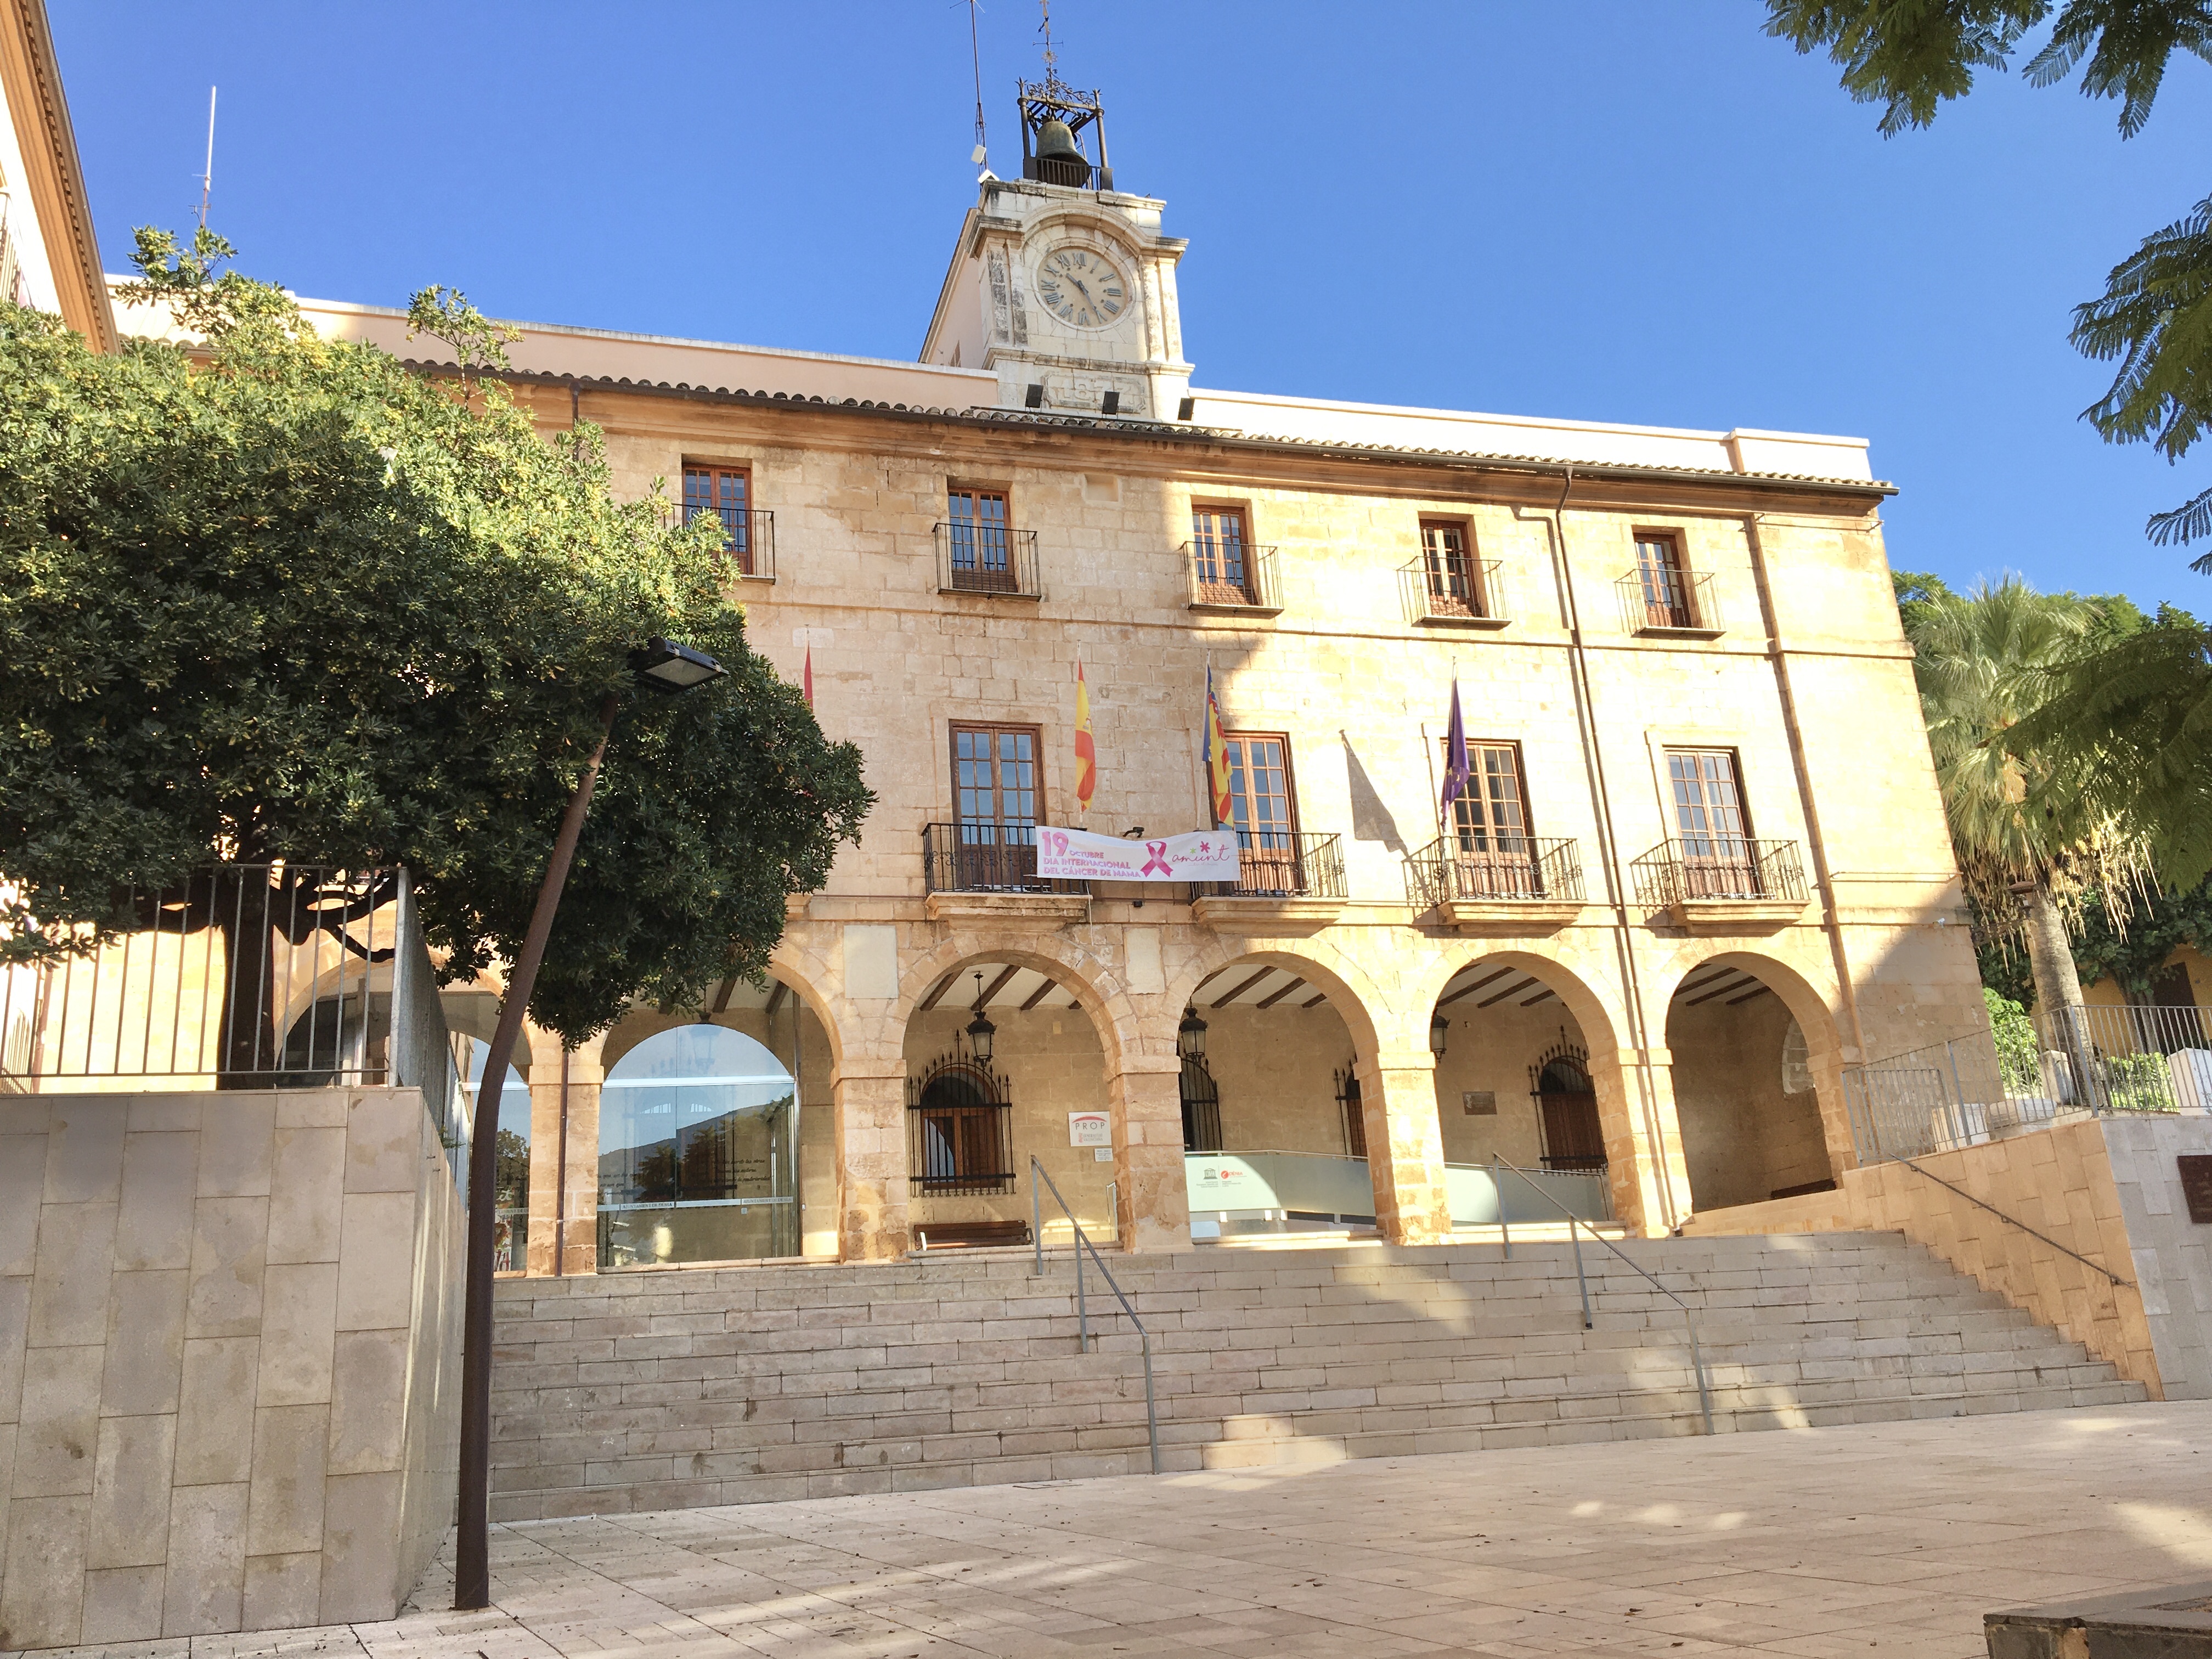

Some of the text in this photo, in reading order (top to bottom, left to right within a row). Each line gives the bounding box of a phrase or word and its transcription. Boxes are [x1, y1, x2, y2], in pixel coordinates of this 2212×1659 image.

[1042, 831, 1104, 859] 19 OCTUBRE
[1043, 857, 1131, 869] DIA INTERNACIONAL
[1043, 866, 1060, 874] DEL
[1062, 866, 1098, 876] CÁNCER
[1113, 870, 1141, 878] MAMA
[1075, 1121, 1105, 1130] PROP
